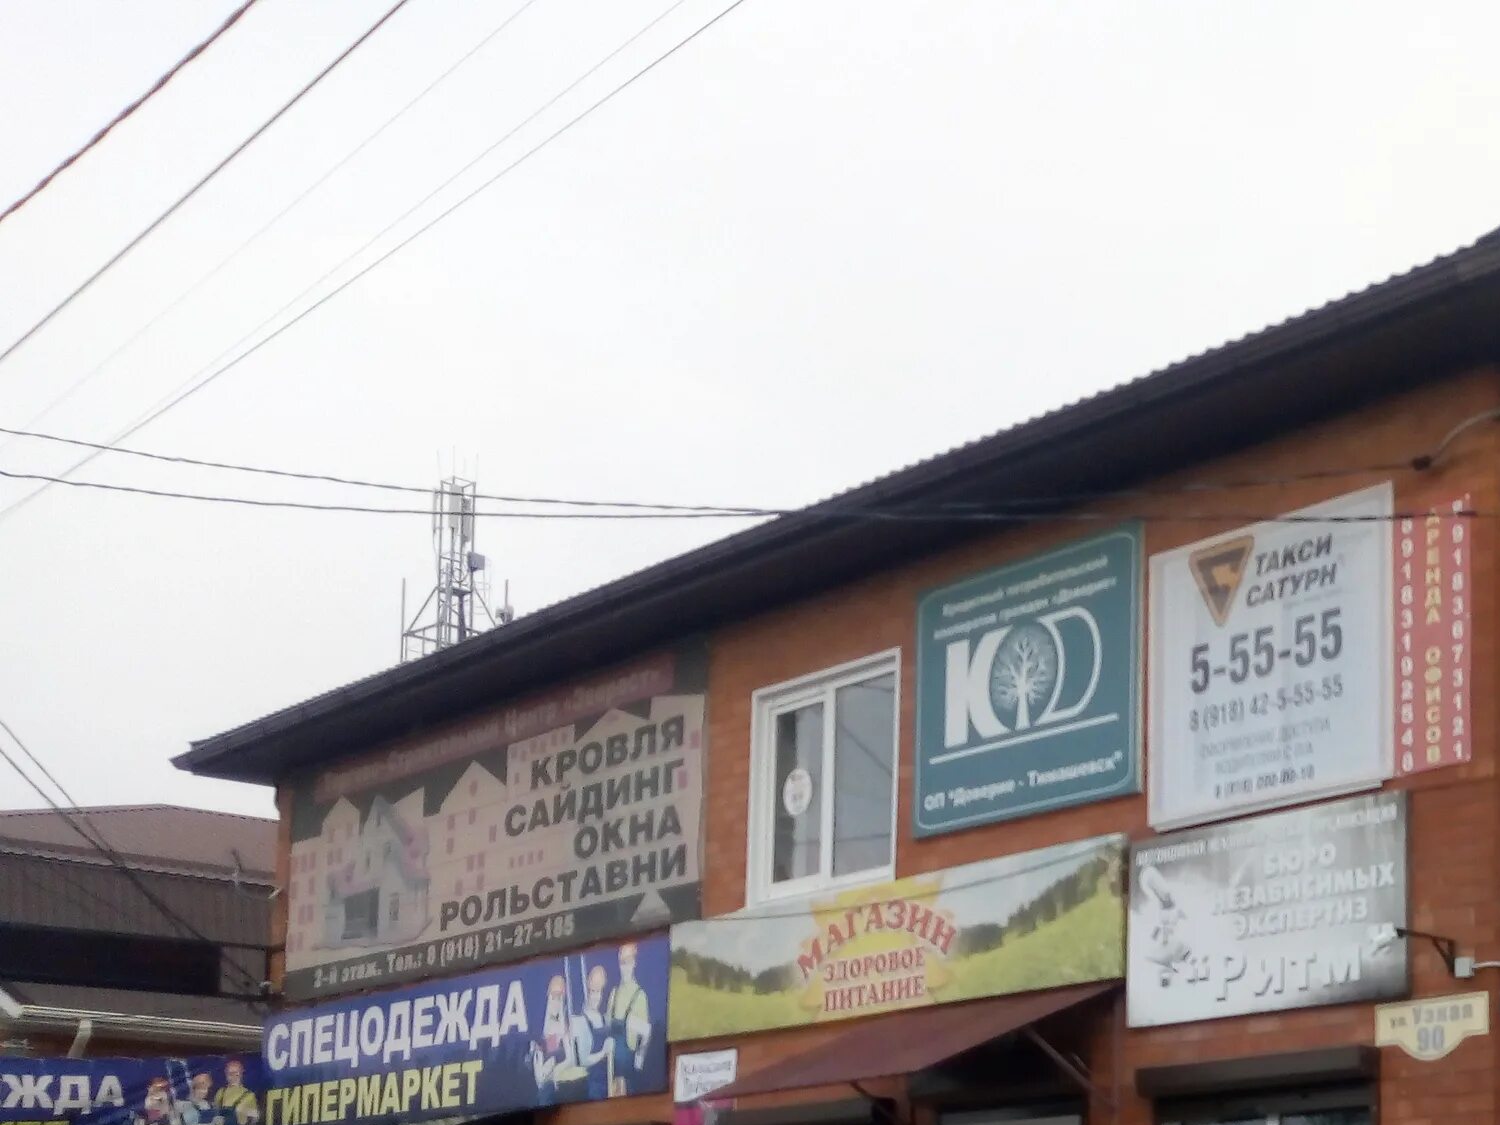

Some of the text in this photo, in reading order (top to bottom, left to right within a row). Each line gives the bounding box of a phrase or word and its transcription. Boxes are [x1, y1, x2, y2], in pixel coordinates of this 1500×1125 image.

[1255, 533, 1332, 576] ТАКСИ
[1246, 563, 1337, 606] САТУРН
[1191, 607, 1343, 693] 5-55-55
[530, 714, 684, 790] КРОВЛЯ
[504, 758, 684, 837] САЙДИНГ
[574, 805, 682, 859] ОКНА
[440, 843, 687, 931] РОЛЬСТАВНИ
[1264, 843, 1337, 879] БЮРО
[1212, 862, 1395, 915] НЕЗАВИСИМЫХ
[797, 898, 957, 980] МАГАЗИН
[1233, 897, 1368, 940] ЭКСПЕРТИЗ
[824, 946, 925, 982] ЗДОРОВОЕ
[824, 976, 925, 1012] ПИТАНИЕ
[267, 980, 528, 1071] СПЕЦОДЕЖДА
[1417, 1025, 1445, 1052] 90
